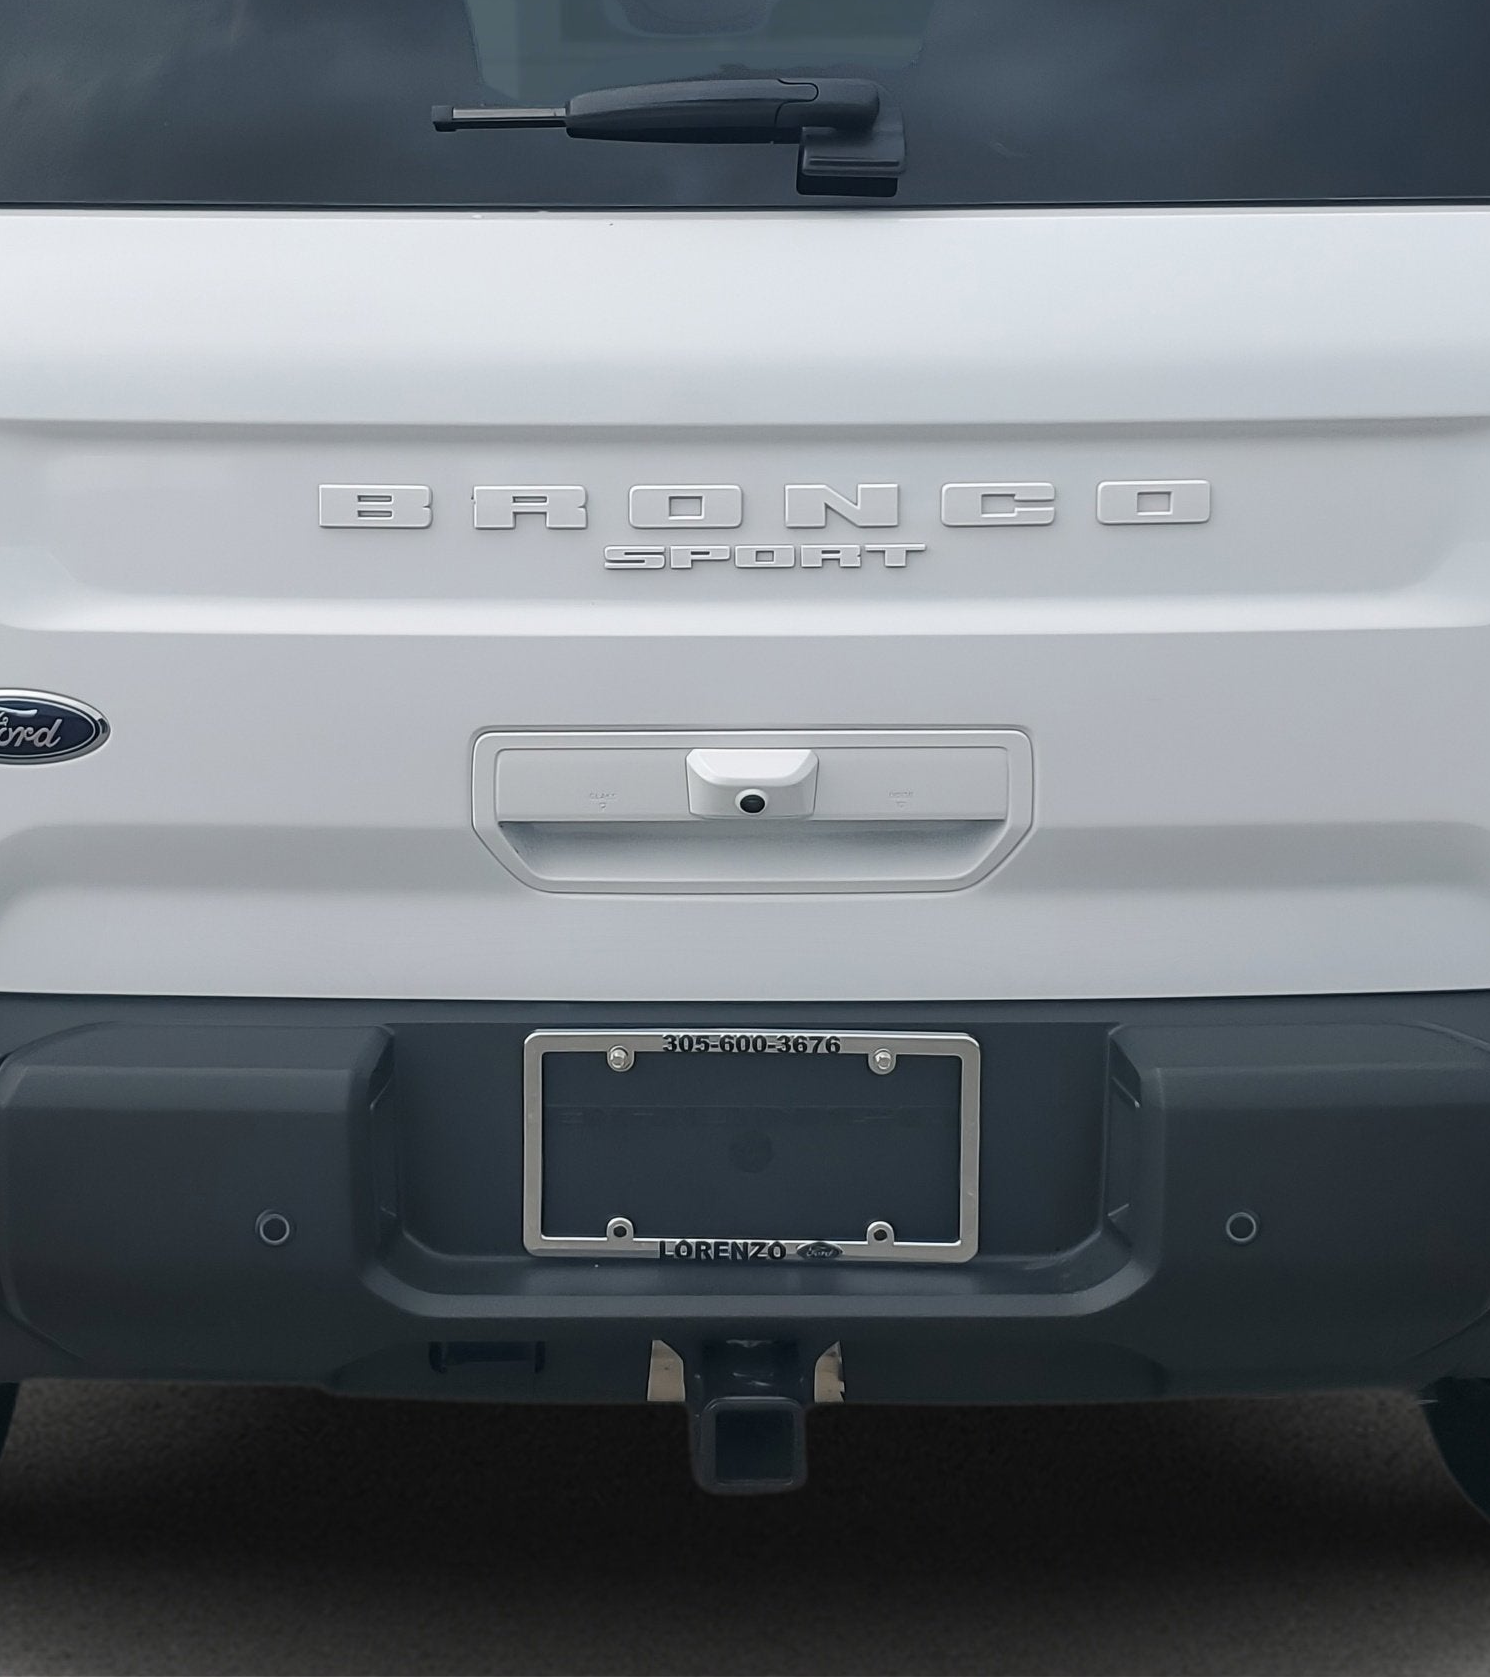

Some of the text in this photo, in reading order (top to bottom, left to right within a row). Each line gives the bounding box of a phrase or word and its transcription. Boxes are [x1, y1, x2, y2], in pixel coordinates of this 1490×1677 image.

[318, 479, 1212, 530] BRONCO
[603, 542, 927, 571] SPORT
[662, 1034, 841, 1054] 305-600-3676
[660, 1239, 787, 1261] LORENZO
